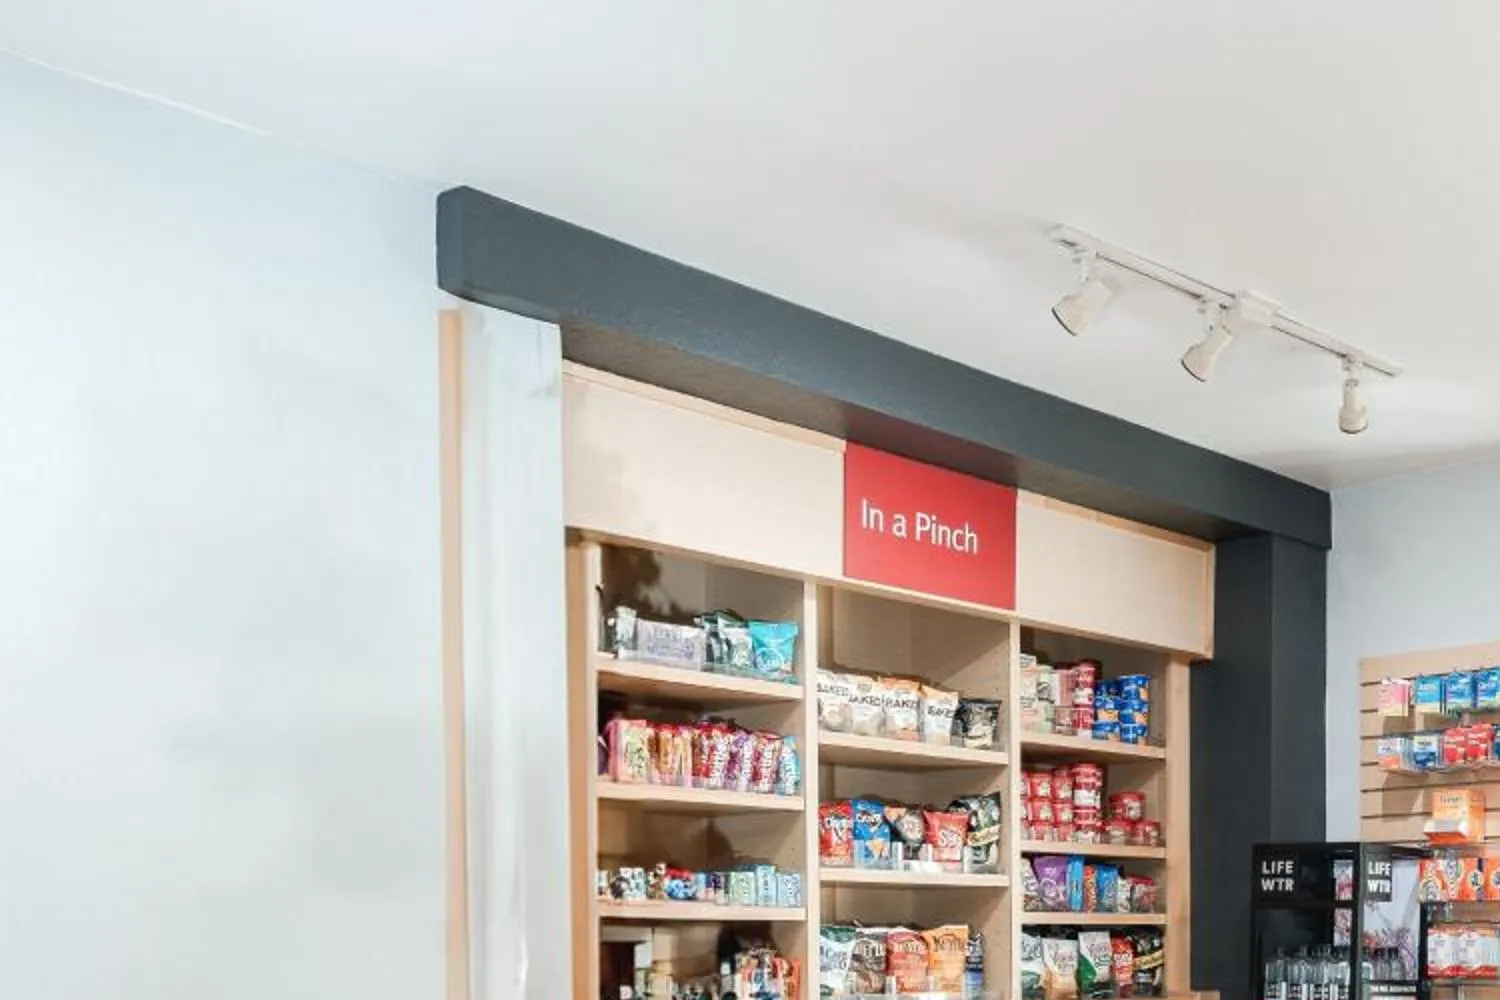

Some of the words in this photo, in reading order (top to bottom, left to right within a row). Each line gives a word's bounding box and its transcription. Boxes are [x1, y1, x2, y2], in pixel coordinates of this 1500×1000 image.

[862, 498, 884, 532] In
[892, 514, 907, 538] a
[915, 511, 978, 554] Pinch
[1262, 860, 1295, 875] LIFE
[1368, 861, 1391, 876] LIFE
[1261, 878, 1295, 892] WTR
[1367, 879, 1391, 893] WTR
